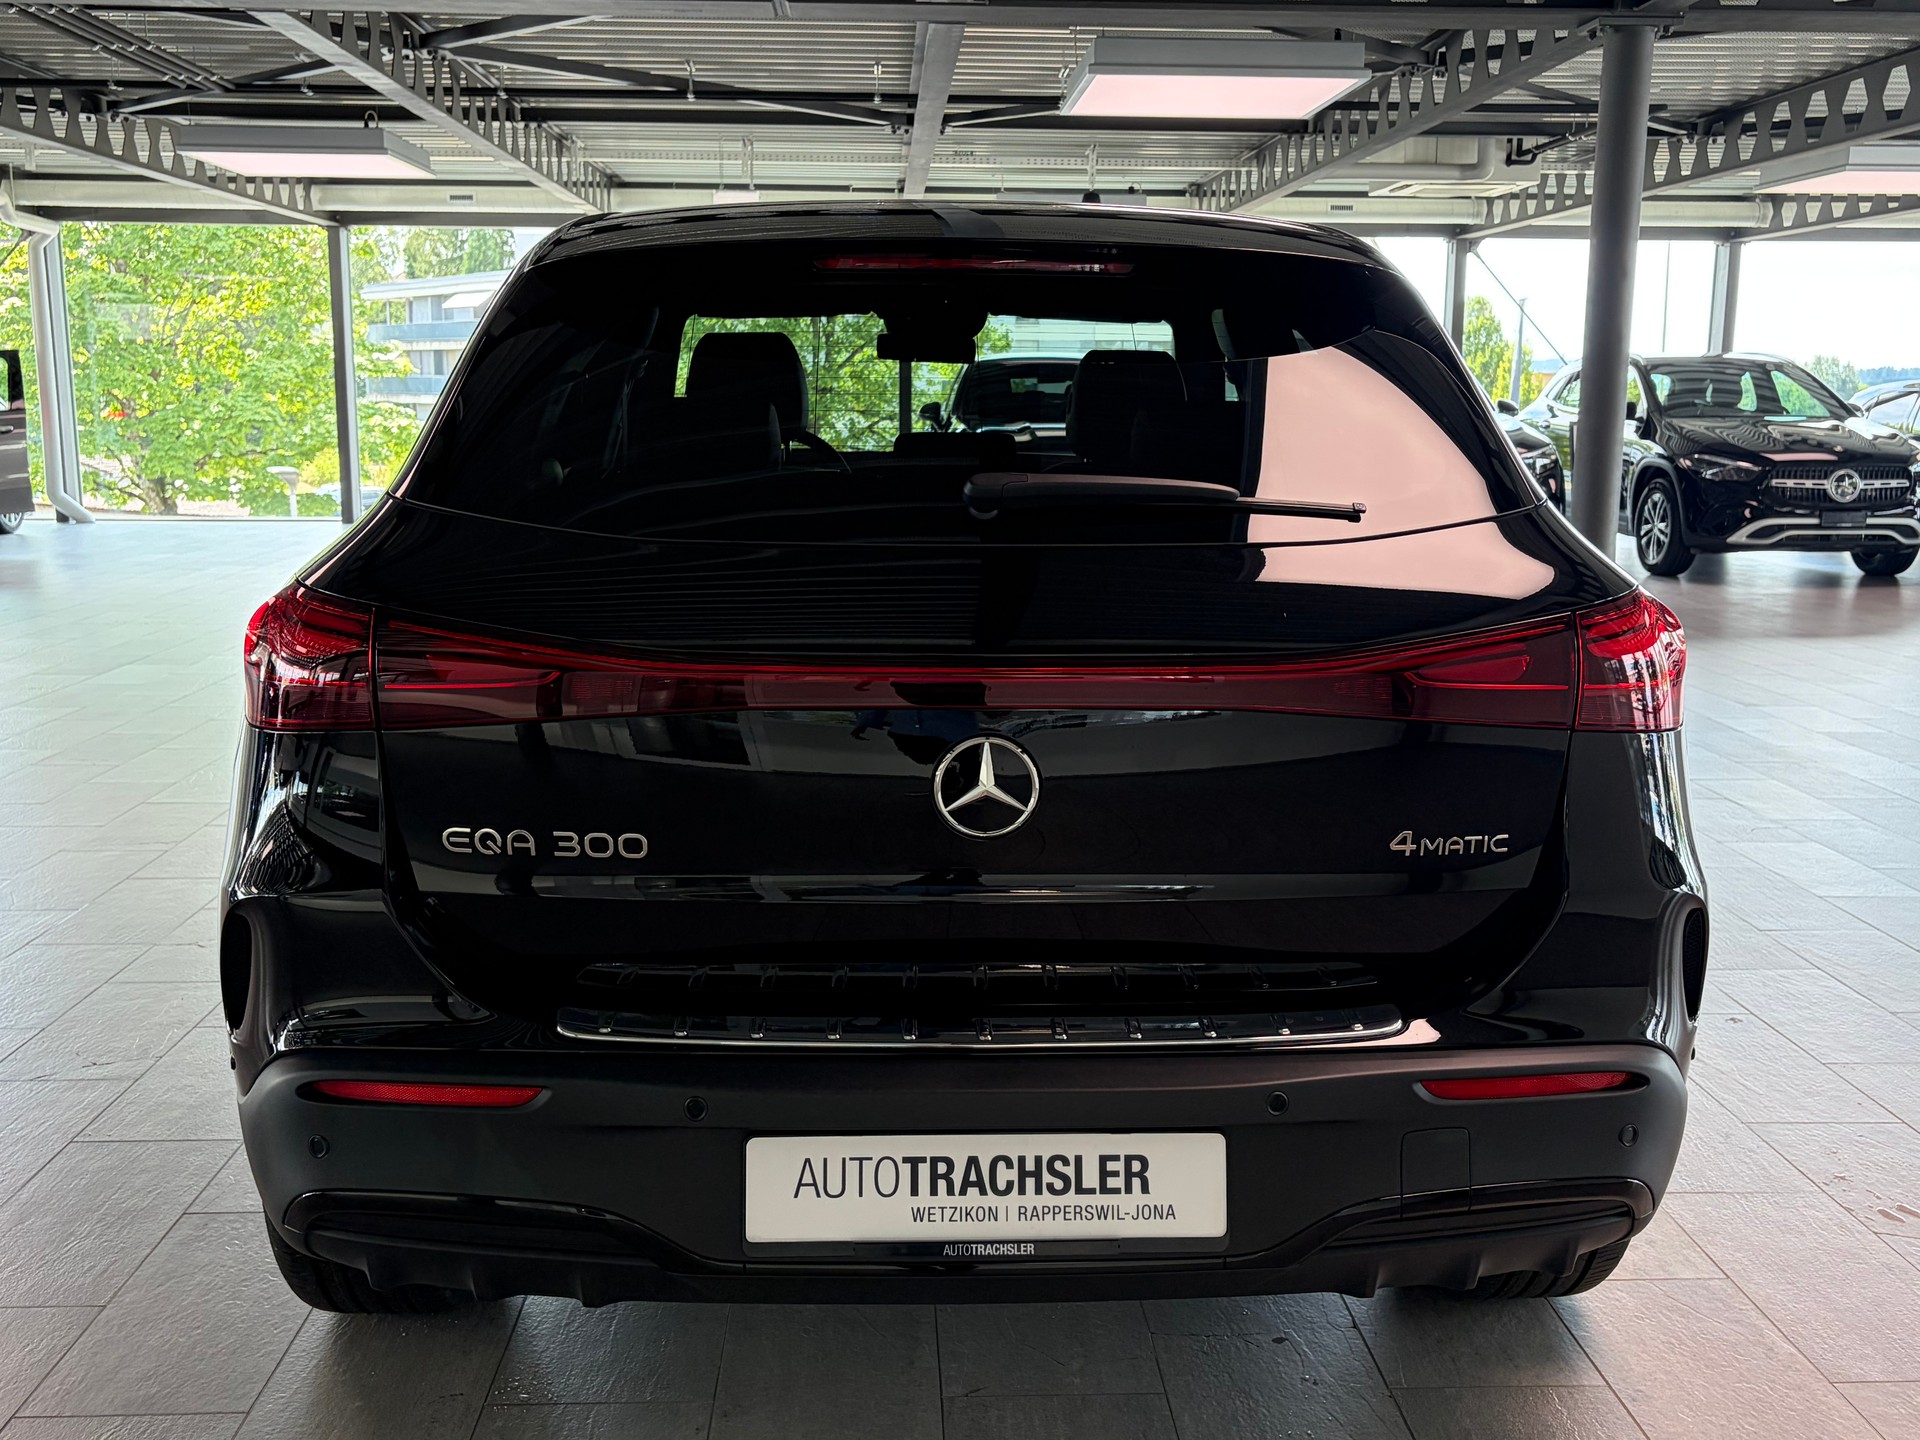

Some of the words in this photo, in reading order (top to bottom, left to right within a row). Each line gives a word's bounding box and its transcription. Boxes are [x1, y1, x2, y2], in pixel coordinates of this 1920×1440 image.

[442, 827, 537, 857] EQA
[553, 831, 648, 859] 300
[1389, 830, 1509, 857] 4MATIC
[793, 1154, 1151, 1199] AUTOTRACHSLER
[911, 1205, 999, 1223] WETZIKON
[1017, 1203, 1177, 1222] RAPPERSWIL-JONA
[943, 1243, 1035, 1256] AUTOTRACHSLER
